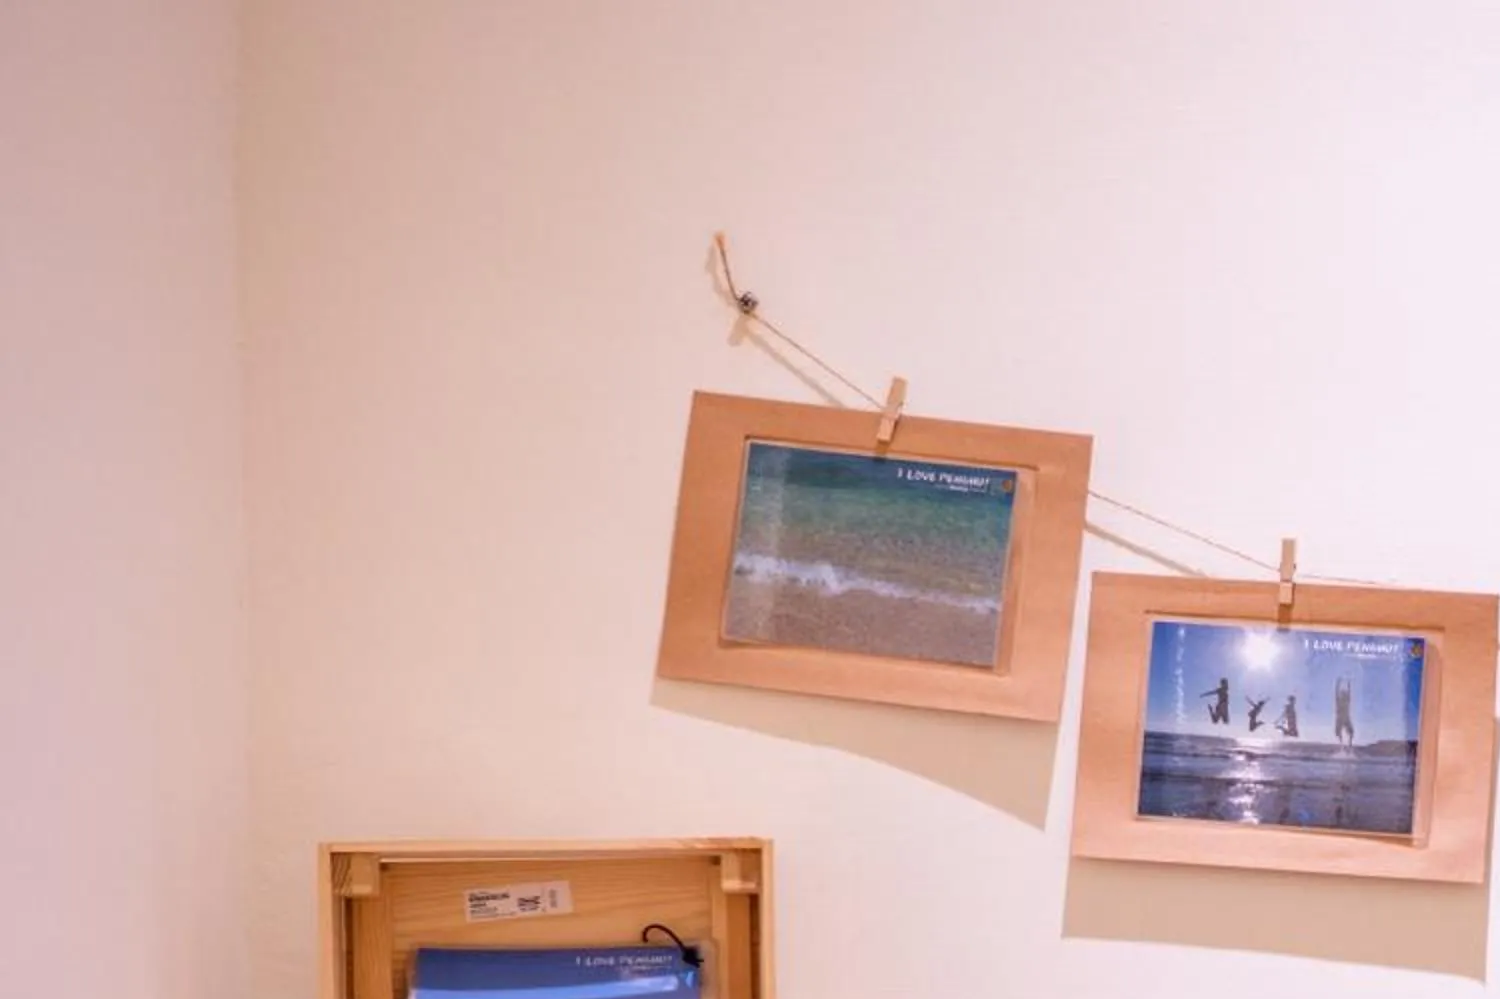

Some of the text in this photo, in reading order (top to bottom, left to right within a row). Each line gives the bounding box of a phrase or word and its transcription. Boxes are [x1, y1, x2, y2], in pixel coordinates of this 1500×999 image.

[907, 469, 935, 482] LOVE
[1313, 639, 1342, 651] LOVE
[586, 956, 615, 966] LOVE
